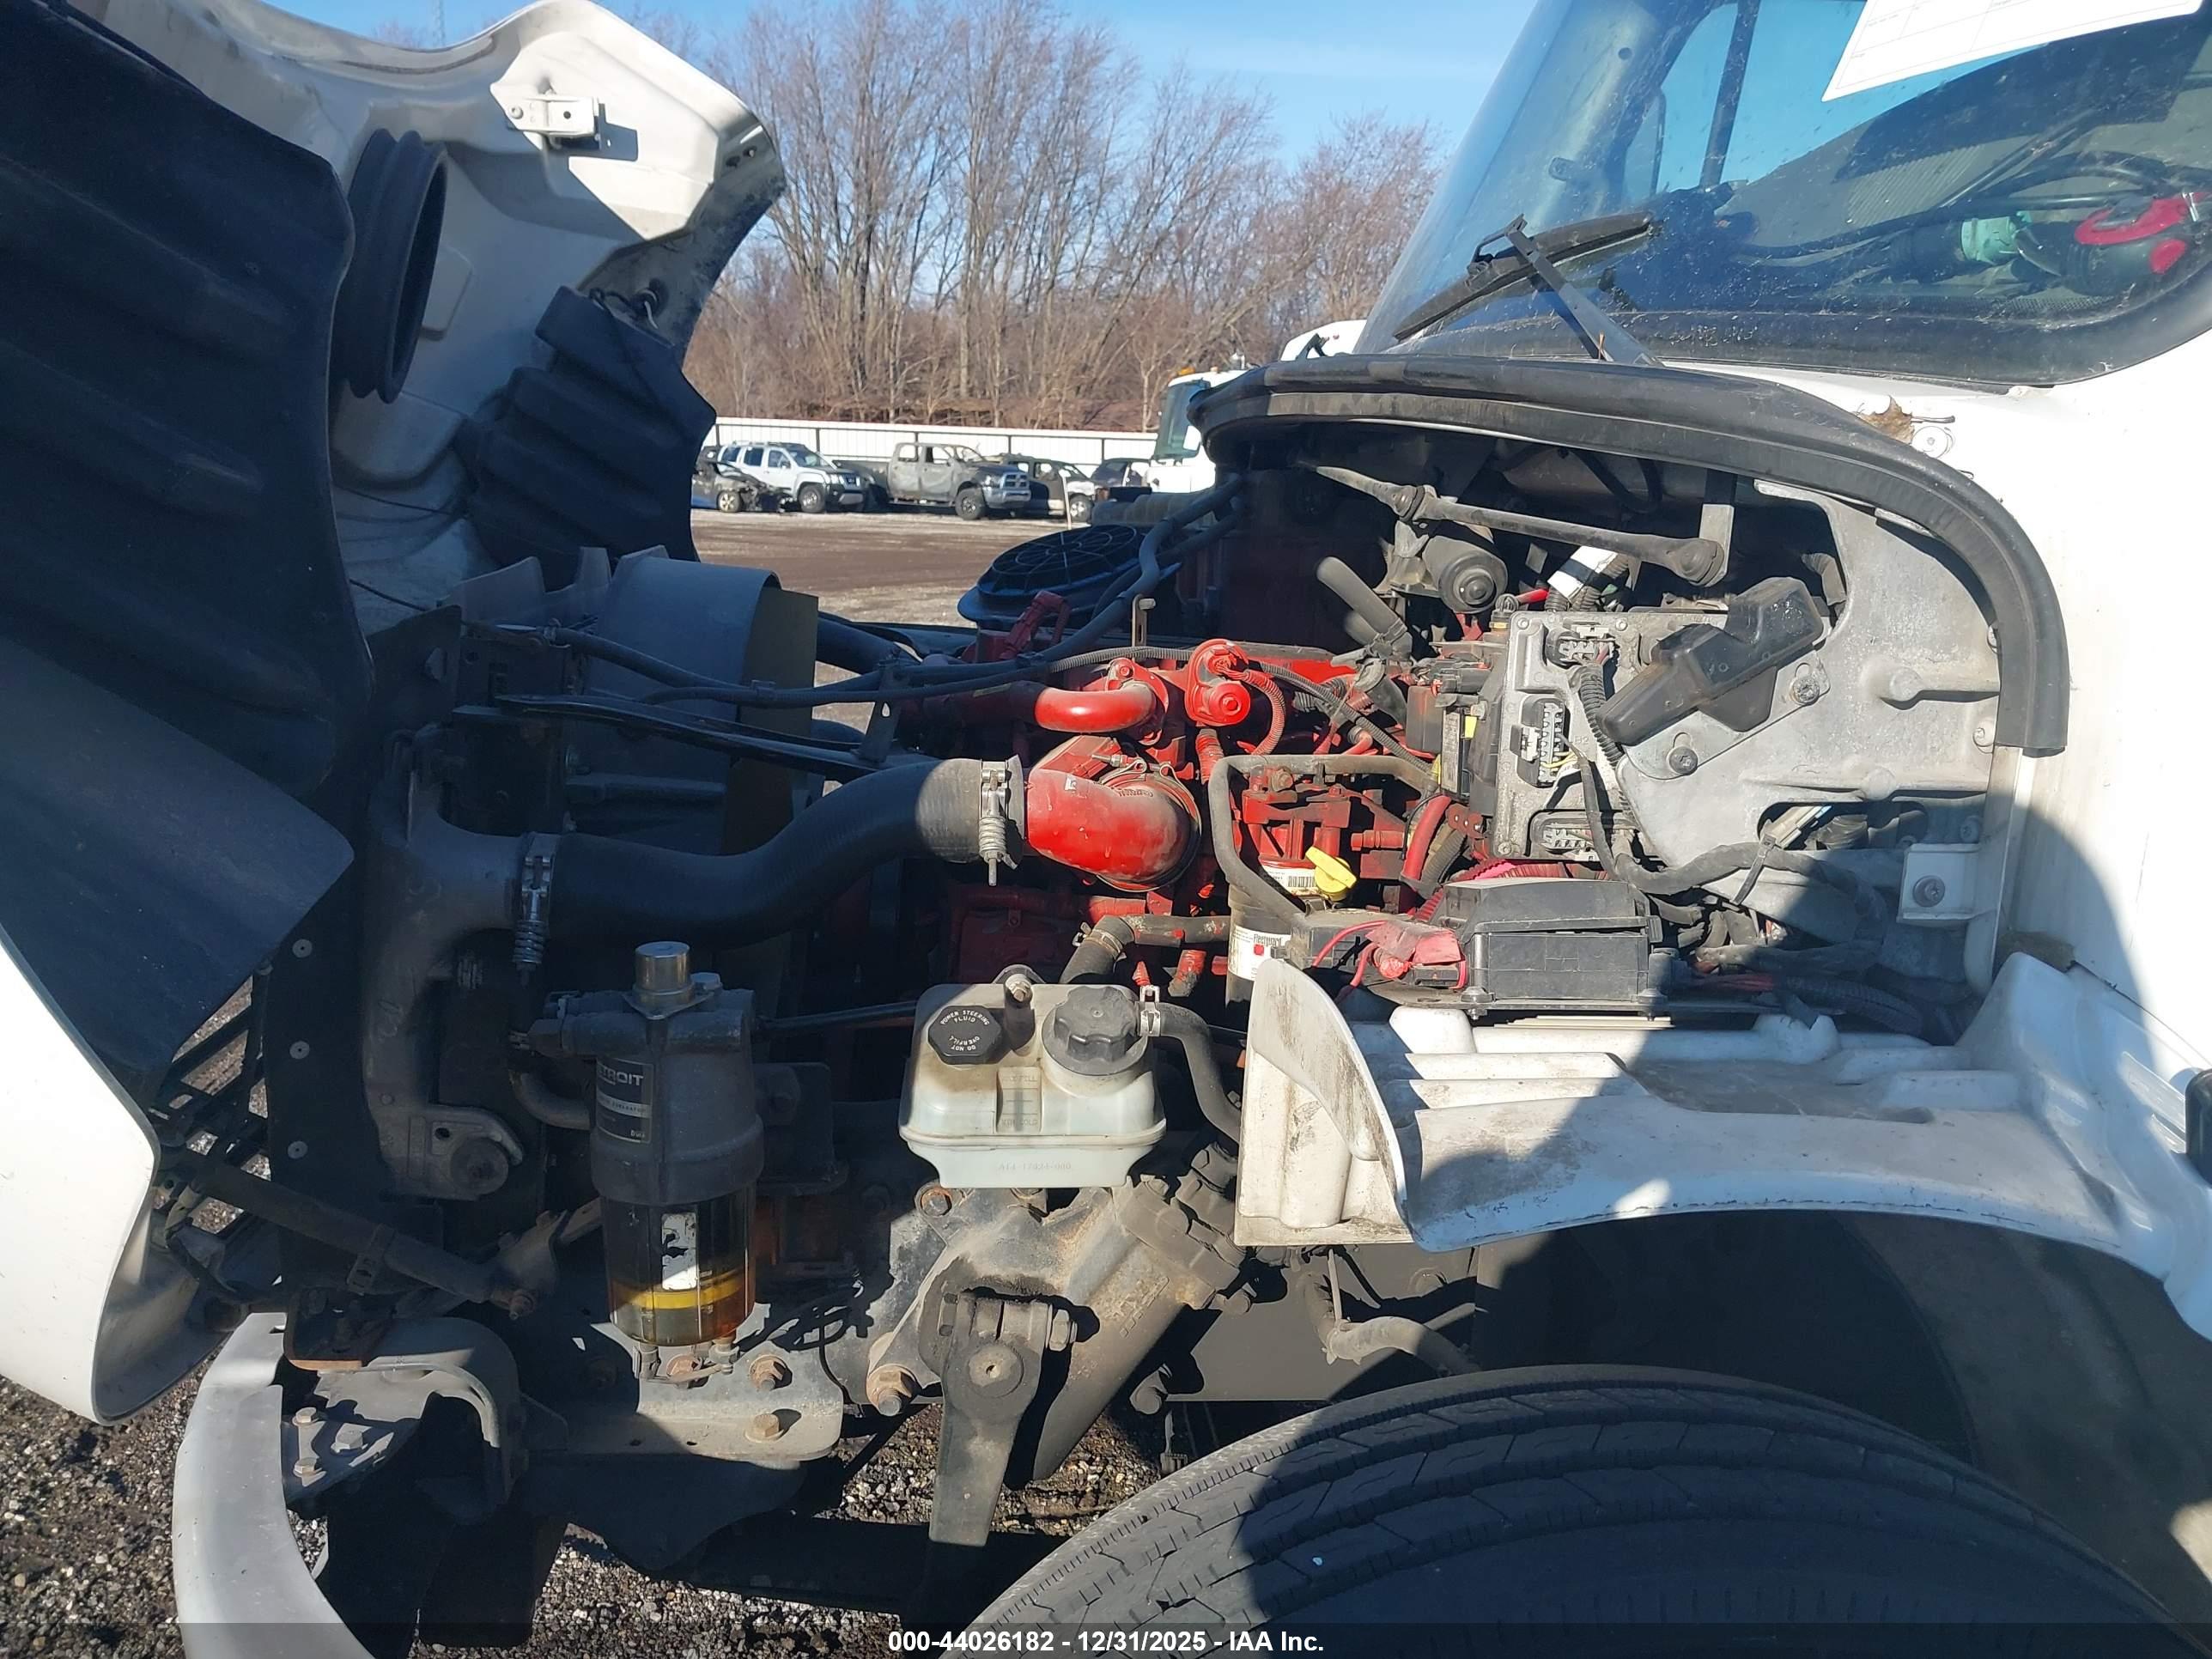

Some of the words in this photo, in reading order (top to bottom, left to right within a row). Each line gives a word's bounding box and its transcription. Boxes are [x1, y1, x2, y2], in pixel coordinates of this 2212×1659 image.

[940, 1011, 959, 1025] POWER
[963, 1010, 990, 1025] STEERING
[954, 1015, 975, 1024] FLUID
[949, 1035, 980, 1046] OVERFILL
